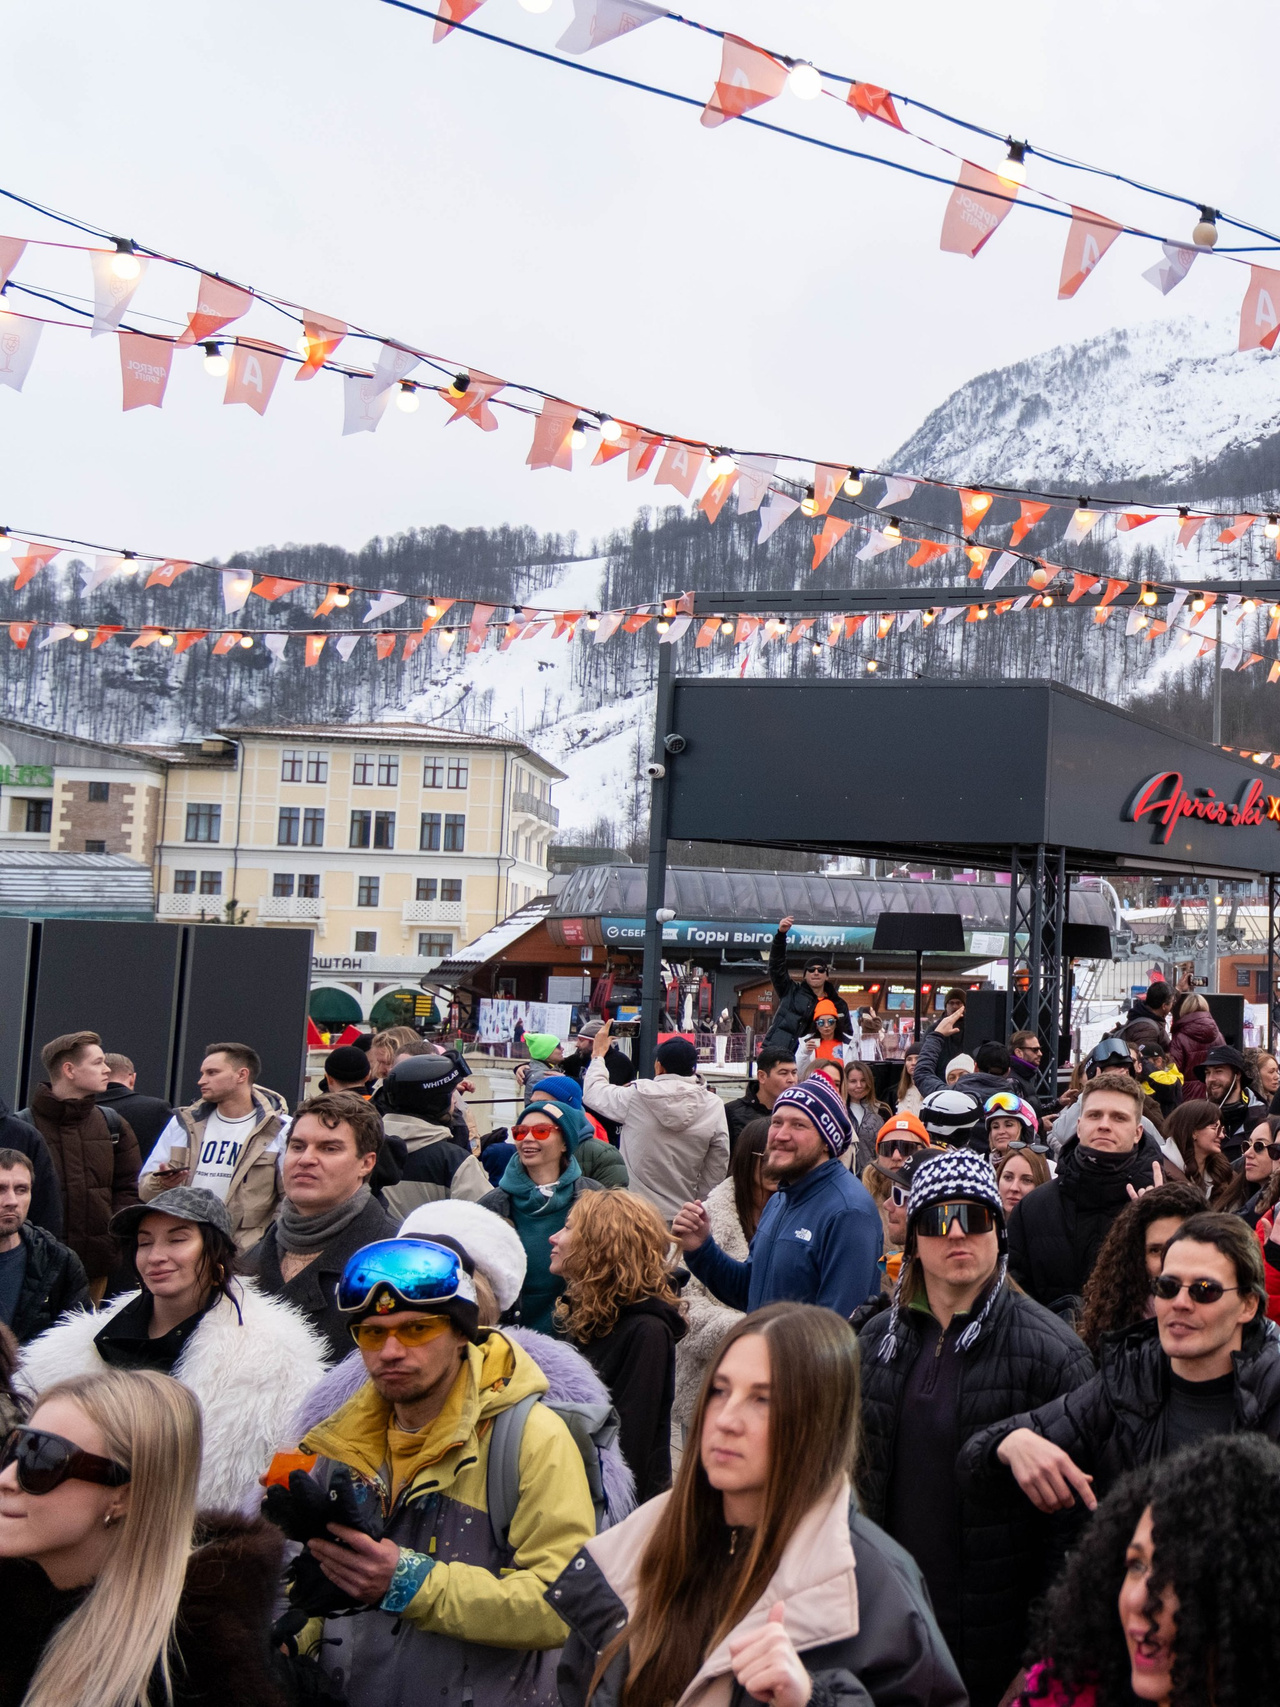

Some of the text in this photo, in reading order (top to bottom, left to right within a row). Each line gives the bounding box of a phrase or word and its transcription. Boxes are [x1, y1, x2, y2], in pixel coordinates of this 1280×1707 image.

[1255, 288, 1278, 330] A
[243, 354, 263, 393] A
[672, 444, 688, 478] A
[159, 565, 174, 577] A
[687, 927, 729, 945] Горы
[733, 932, 795, 945] выгоы
[799, 932, 846, 947] ждут!
[423, 1069, 459, 1090] WHITELAB
[780, 1089, 816, 1106] ОРТ
[199, 1140, 243, 1168] OEN
